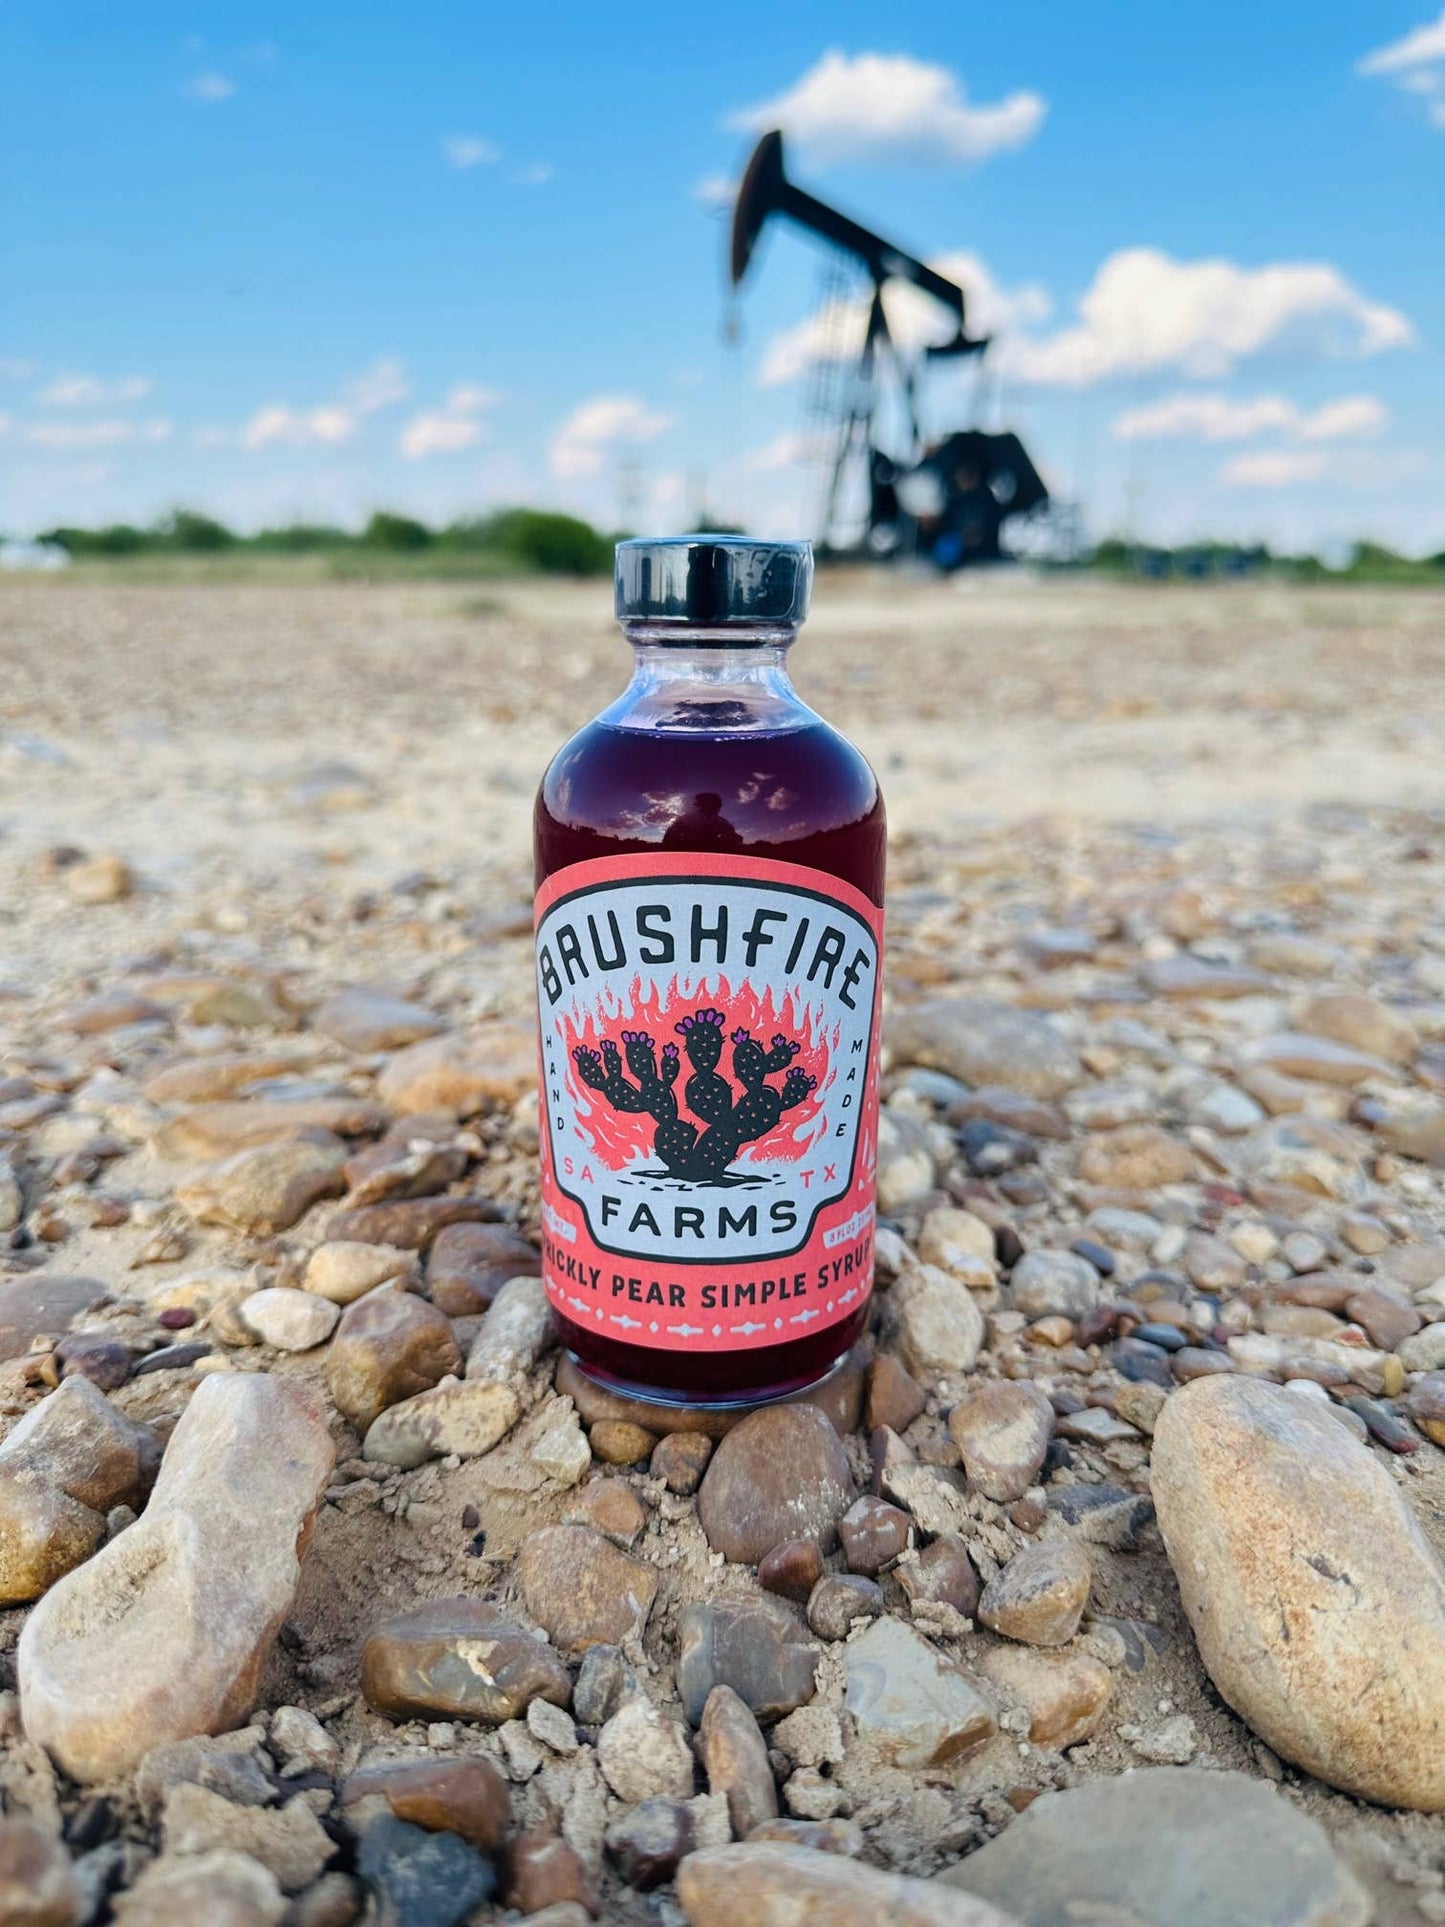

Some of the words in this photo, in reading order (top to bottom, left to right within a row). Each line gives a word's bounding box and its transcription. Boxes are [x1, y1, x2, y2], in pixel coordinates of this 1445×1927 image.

[539, 904, 871, 1010] BRUSHFIRE
[546, 1035, 565, 1130] HAND
[835, 1039, 863, 1137] MADE
[563, 1156, 594, 1183] SA
[800, 1163, 836, 1189] TX
[601, 1195, 798, 1239] FARMS
[544, 1233, 601, 1290] RICKLY
[611, 1274, 686, 1308] PEAR
[701, 1272, 807, 1309] SIMPLE
[817, 1238, 870, 1289] SYRUP
